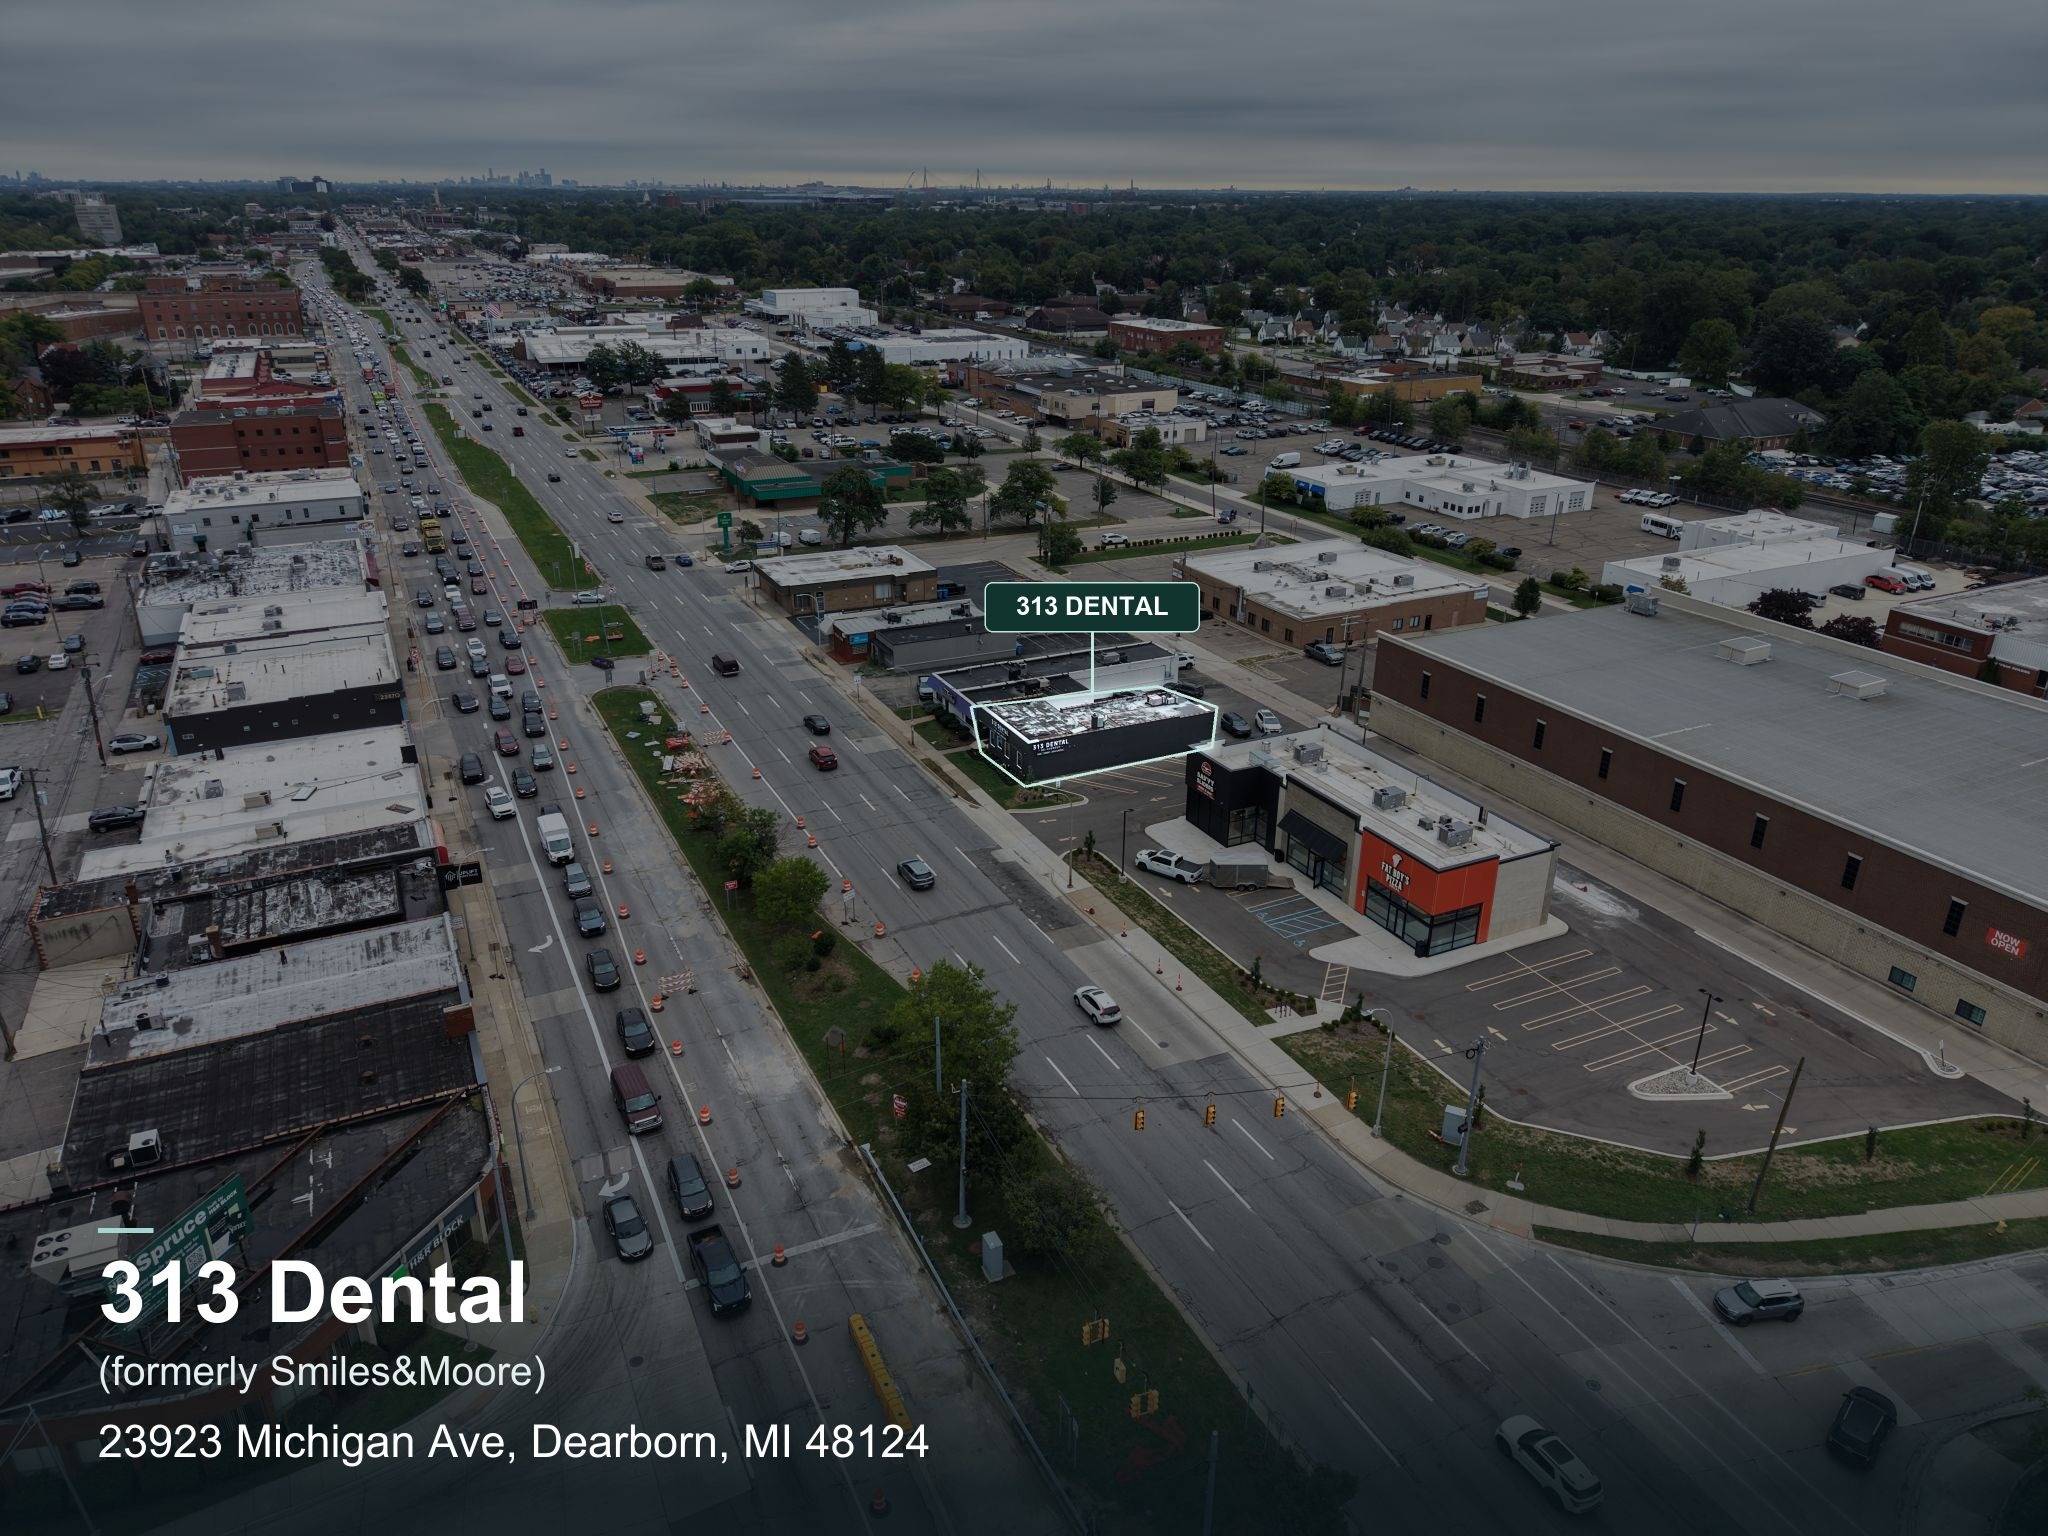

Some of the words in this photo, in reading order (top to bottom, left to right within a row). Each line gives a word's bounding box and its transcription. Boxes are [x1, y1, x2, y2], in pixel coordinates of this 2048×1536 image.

[1045, 738, 1069, 748] DENTAL
[1381, 861, 1392, 874] FAT
[1385, 873, 1403, 891] PIZZA
[1990, 937, 2020, 956] OPEN
[1994, 930, 2021, 947] NOW
[220, 1188, 238, 1204] BLOCK
[135, 1209, 208, 1272] Spruce
[409, 1247, 432, 1270] H&R
[433, 1214, 464, 1248] BLOCK
